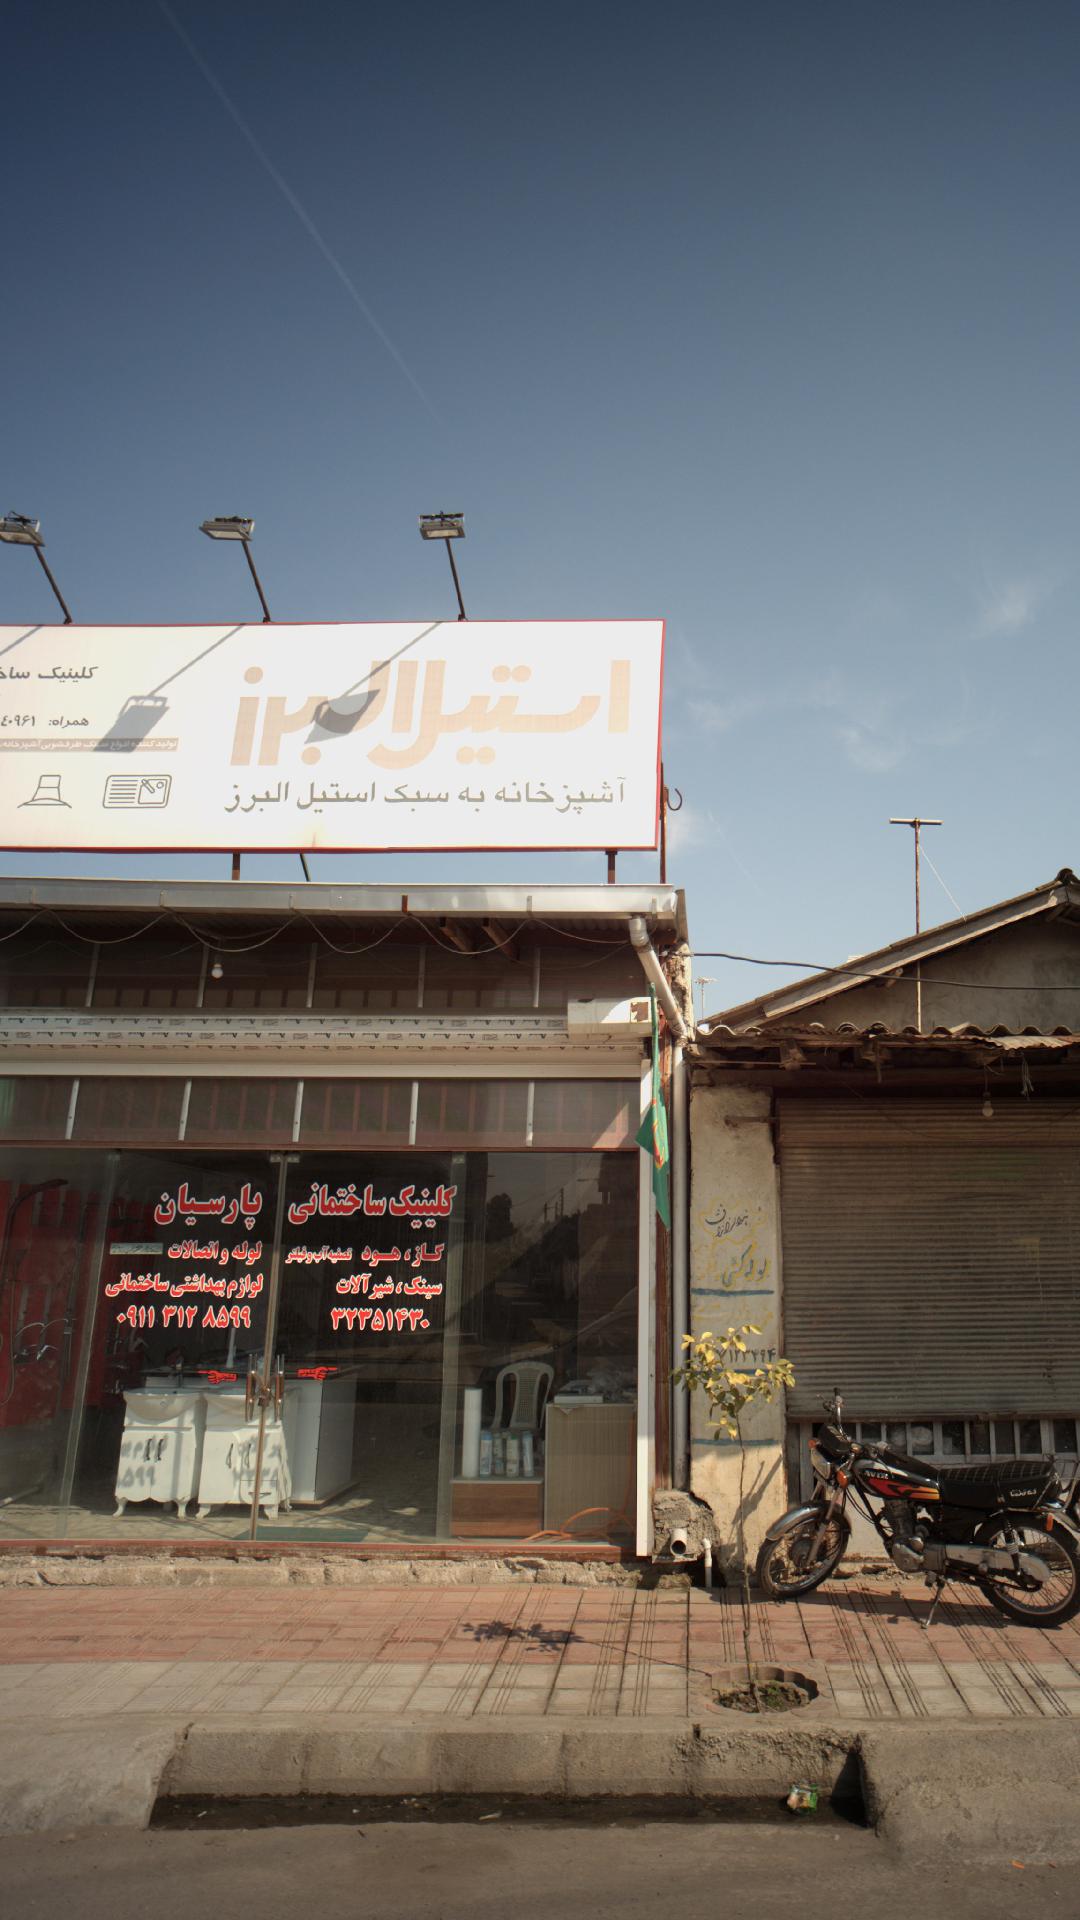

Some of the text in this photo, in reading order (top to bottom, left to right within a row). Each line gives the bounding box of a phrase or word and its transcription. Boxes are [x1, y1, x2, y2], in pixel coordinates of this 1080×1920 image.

[38, 666, 98, 683] کلینیک
[48, 716, 89, 729] همراه:
[229, 659, 632, 770] استیل البرز
[224, 777, 626, 815] آشپزخانه به سبک استیل البرز
[154, 1182, 263, 1229] پارسیان
[288, 1182, 457, 1228] کلینیک ساختمانی
[167, 1240, 219, 1259] اتصالات
[219, 1248, 229, 1265] و
[232, 1241, 263, 1264] لوله
[361, 1245, 401, 1266] هود
[105, 1273, 263, 1298] لوازم بهداشتی ساختمانی
[116, 1305, 251, 1328] ۰۹۱۱ ۳۱۲ ۸۵۹۹
[330, 1307, 430, 1331] ۳۲۳۵۱۴۳۰
